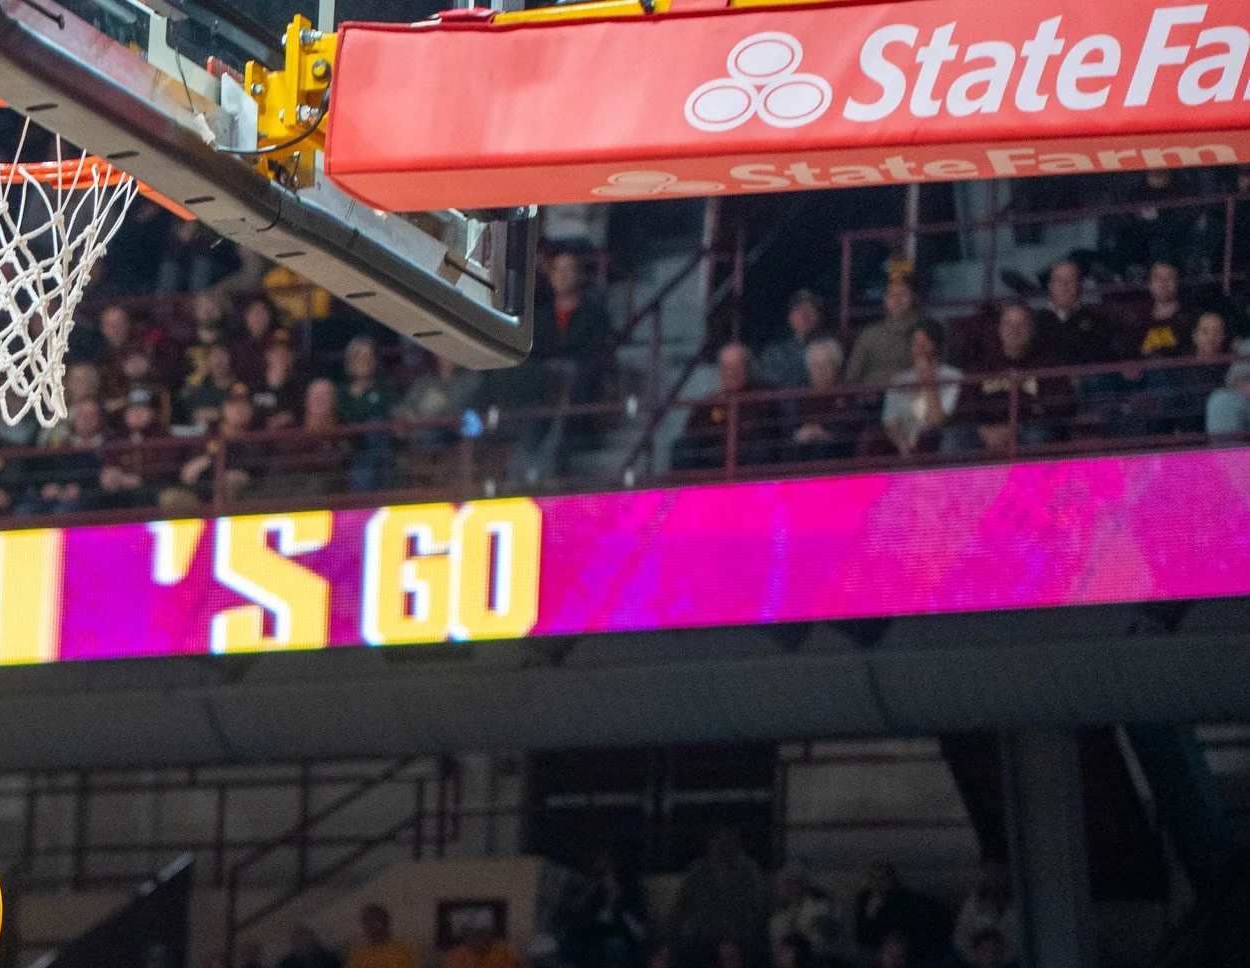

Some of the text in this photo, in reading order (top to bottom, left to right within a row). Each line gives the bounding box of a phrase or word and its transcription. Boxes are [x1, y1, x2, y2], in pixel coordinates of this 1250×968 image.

[842, 3, 1250, 123] State Fa
[730, 143, 1238, 190] State Farm
